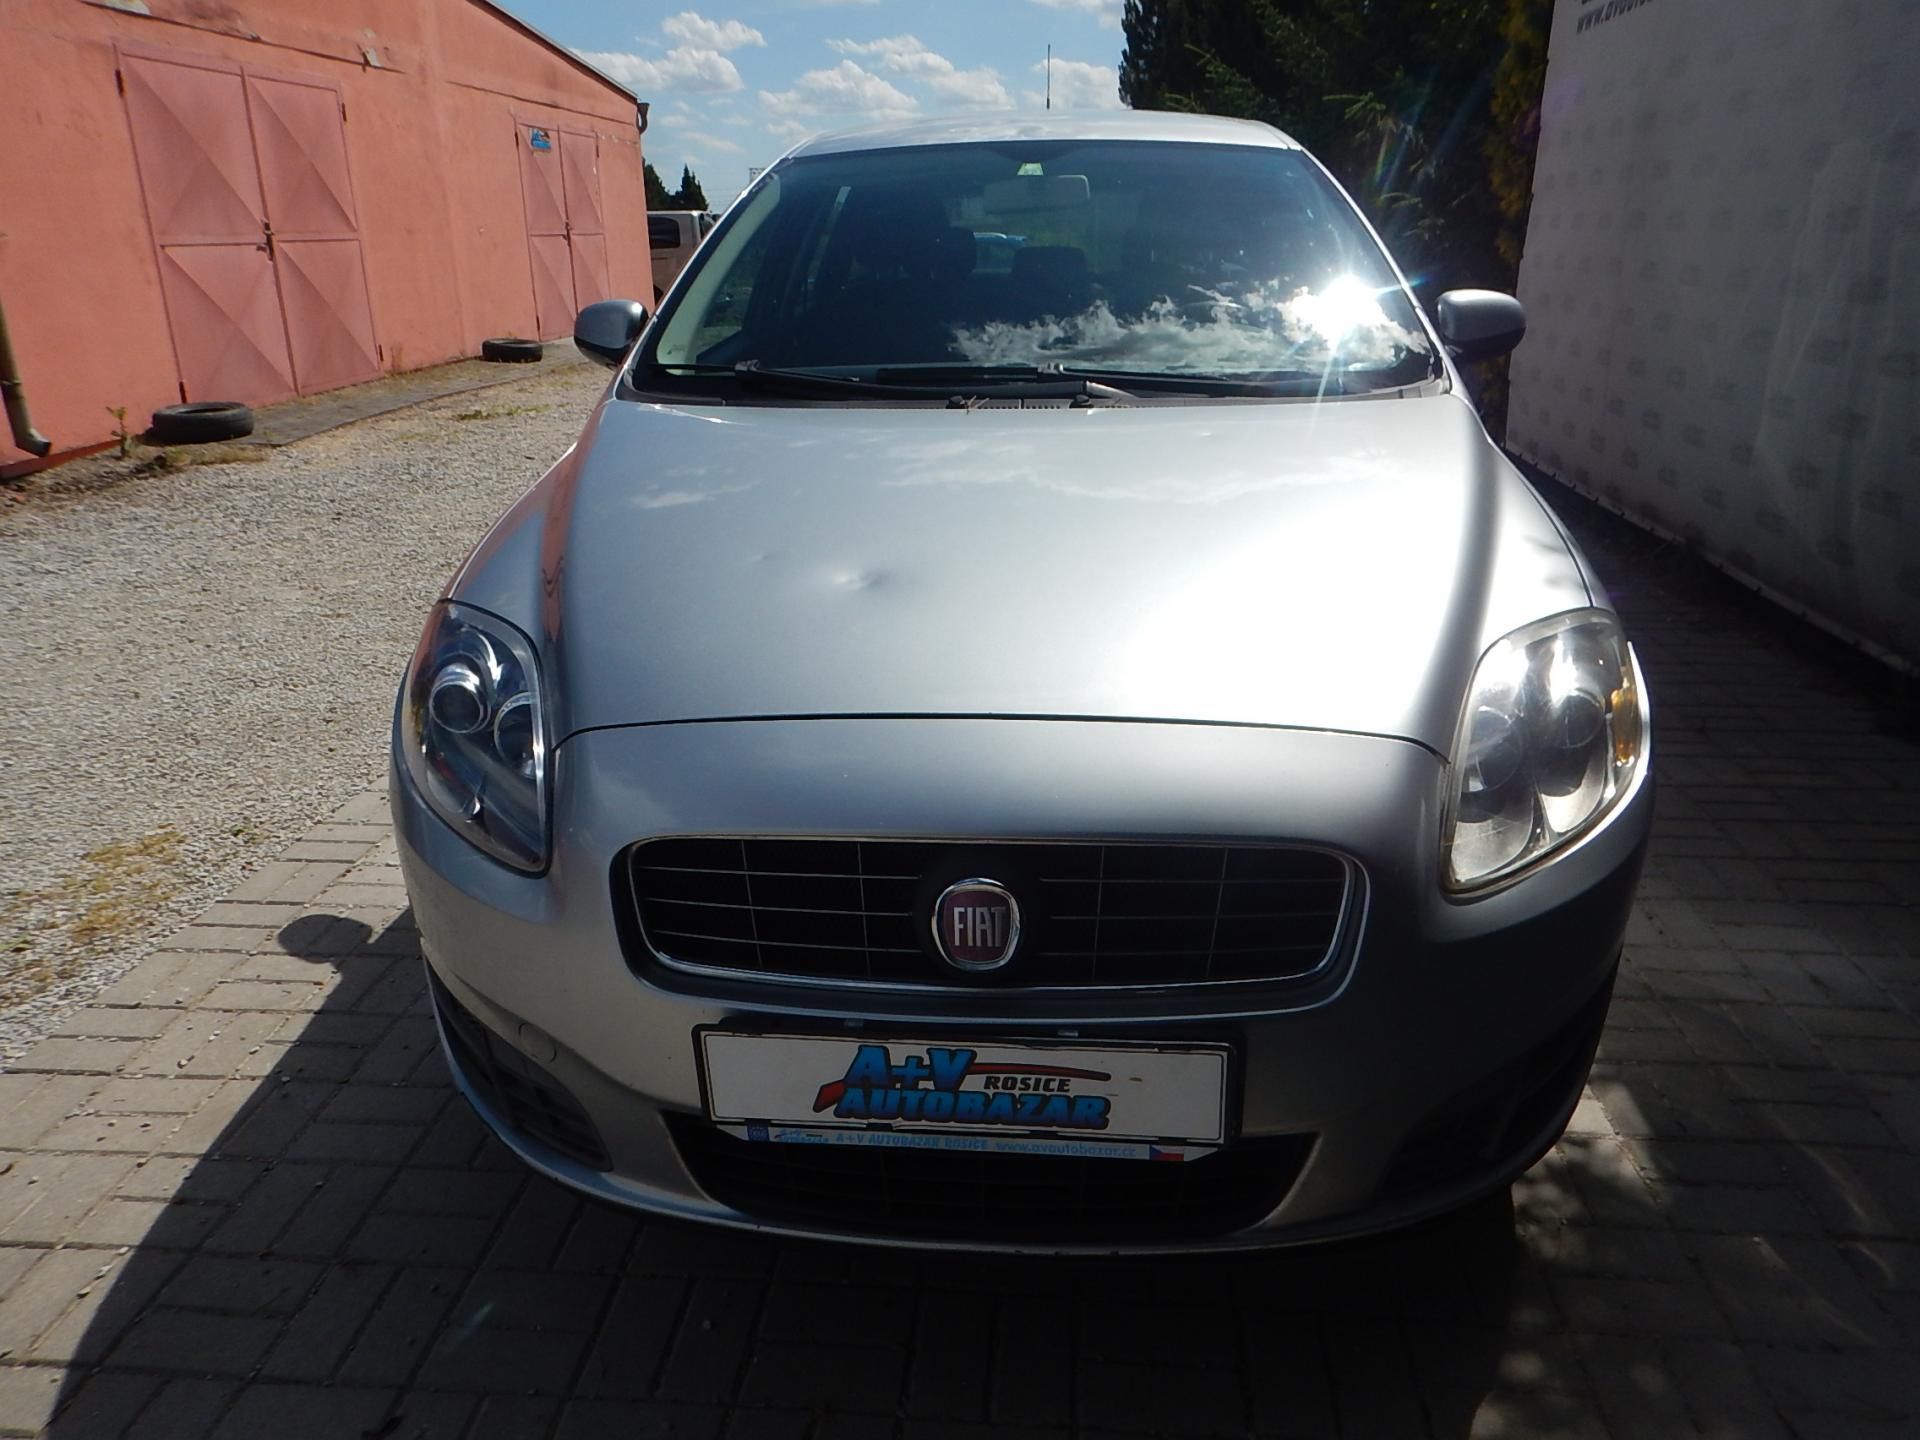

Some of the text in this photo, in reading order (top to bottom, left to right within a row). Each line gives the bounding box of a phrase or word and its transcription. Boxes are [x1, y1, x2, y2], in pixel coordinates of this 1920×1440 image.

[953, 906, 1006, 947] FIAT
[843, 1044, 977, 1090] A+V
[983, 1076, 1071, 1093] ROSICE
[833, 1086, 1110, 1130] AUTOBAZAR
[868, 1134, 939, 1149] AUTOBAZAR
[944, 1138, 987, 1150] ROSICE
[995, 1142, 1136, 1157] www.avautobazar.cz
